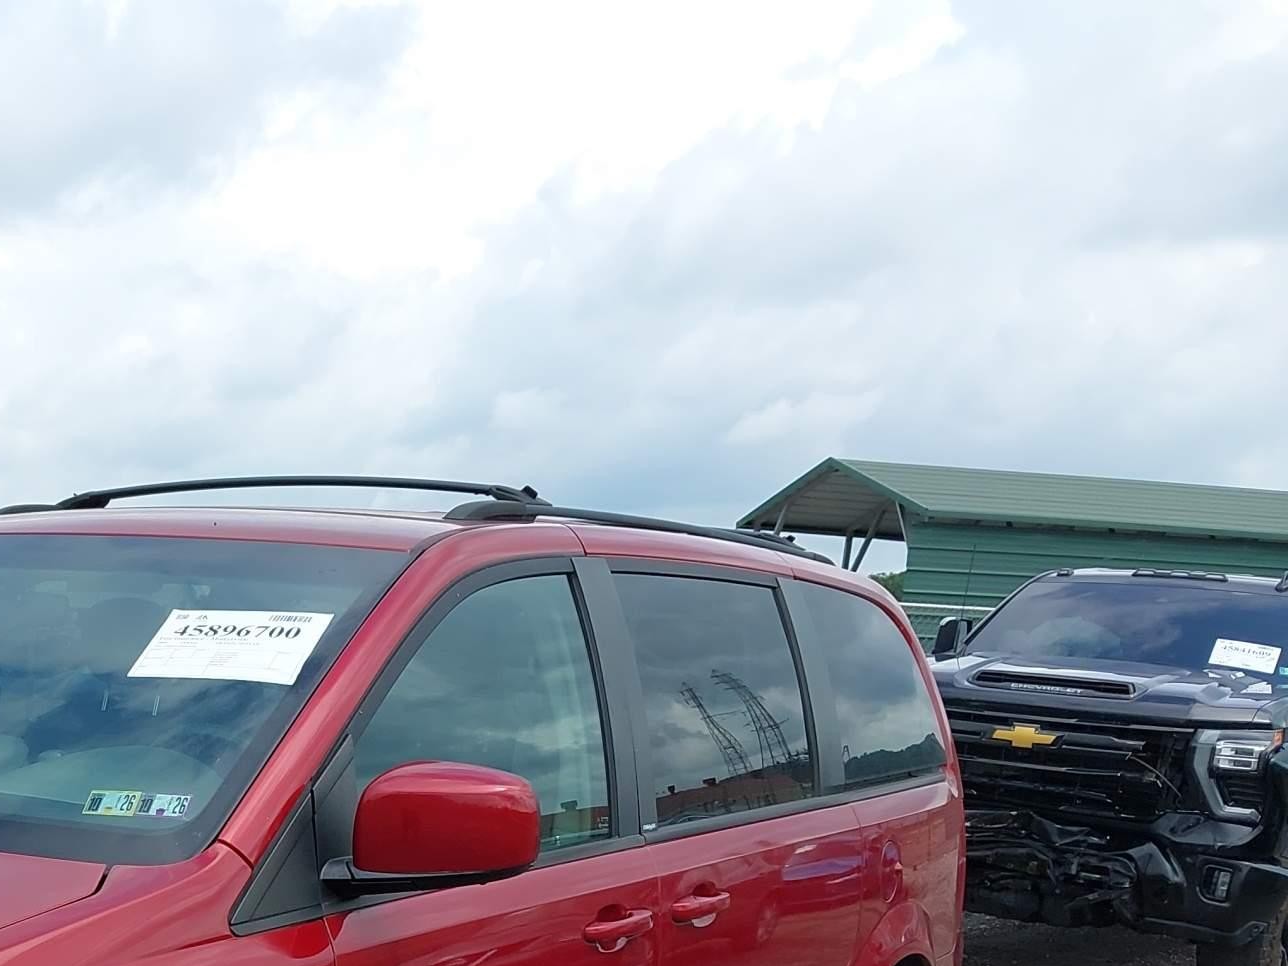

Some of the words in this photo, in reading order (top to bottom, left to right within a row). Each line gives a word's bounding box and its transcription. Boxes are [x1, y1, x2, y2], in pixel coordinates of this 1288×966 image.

[173, 624, 302, 639] 45896700
[88, 797, 103, 811] 10
[120, 795, 136, 811] 26
[139, 798, 153, 813] 10
[172, 797, 188, 814] 26
